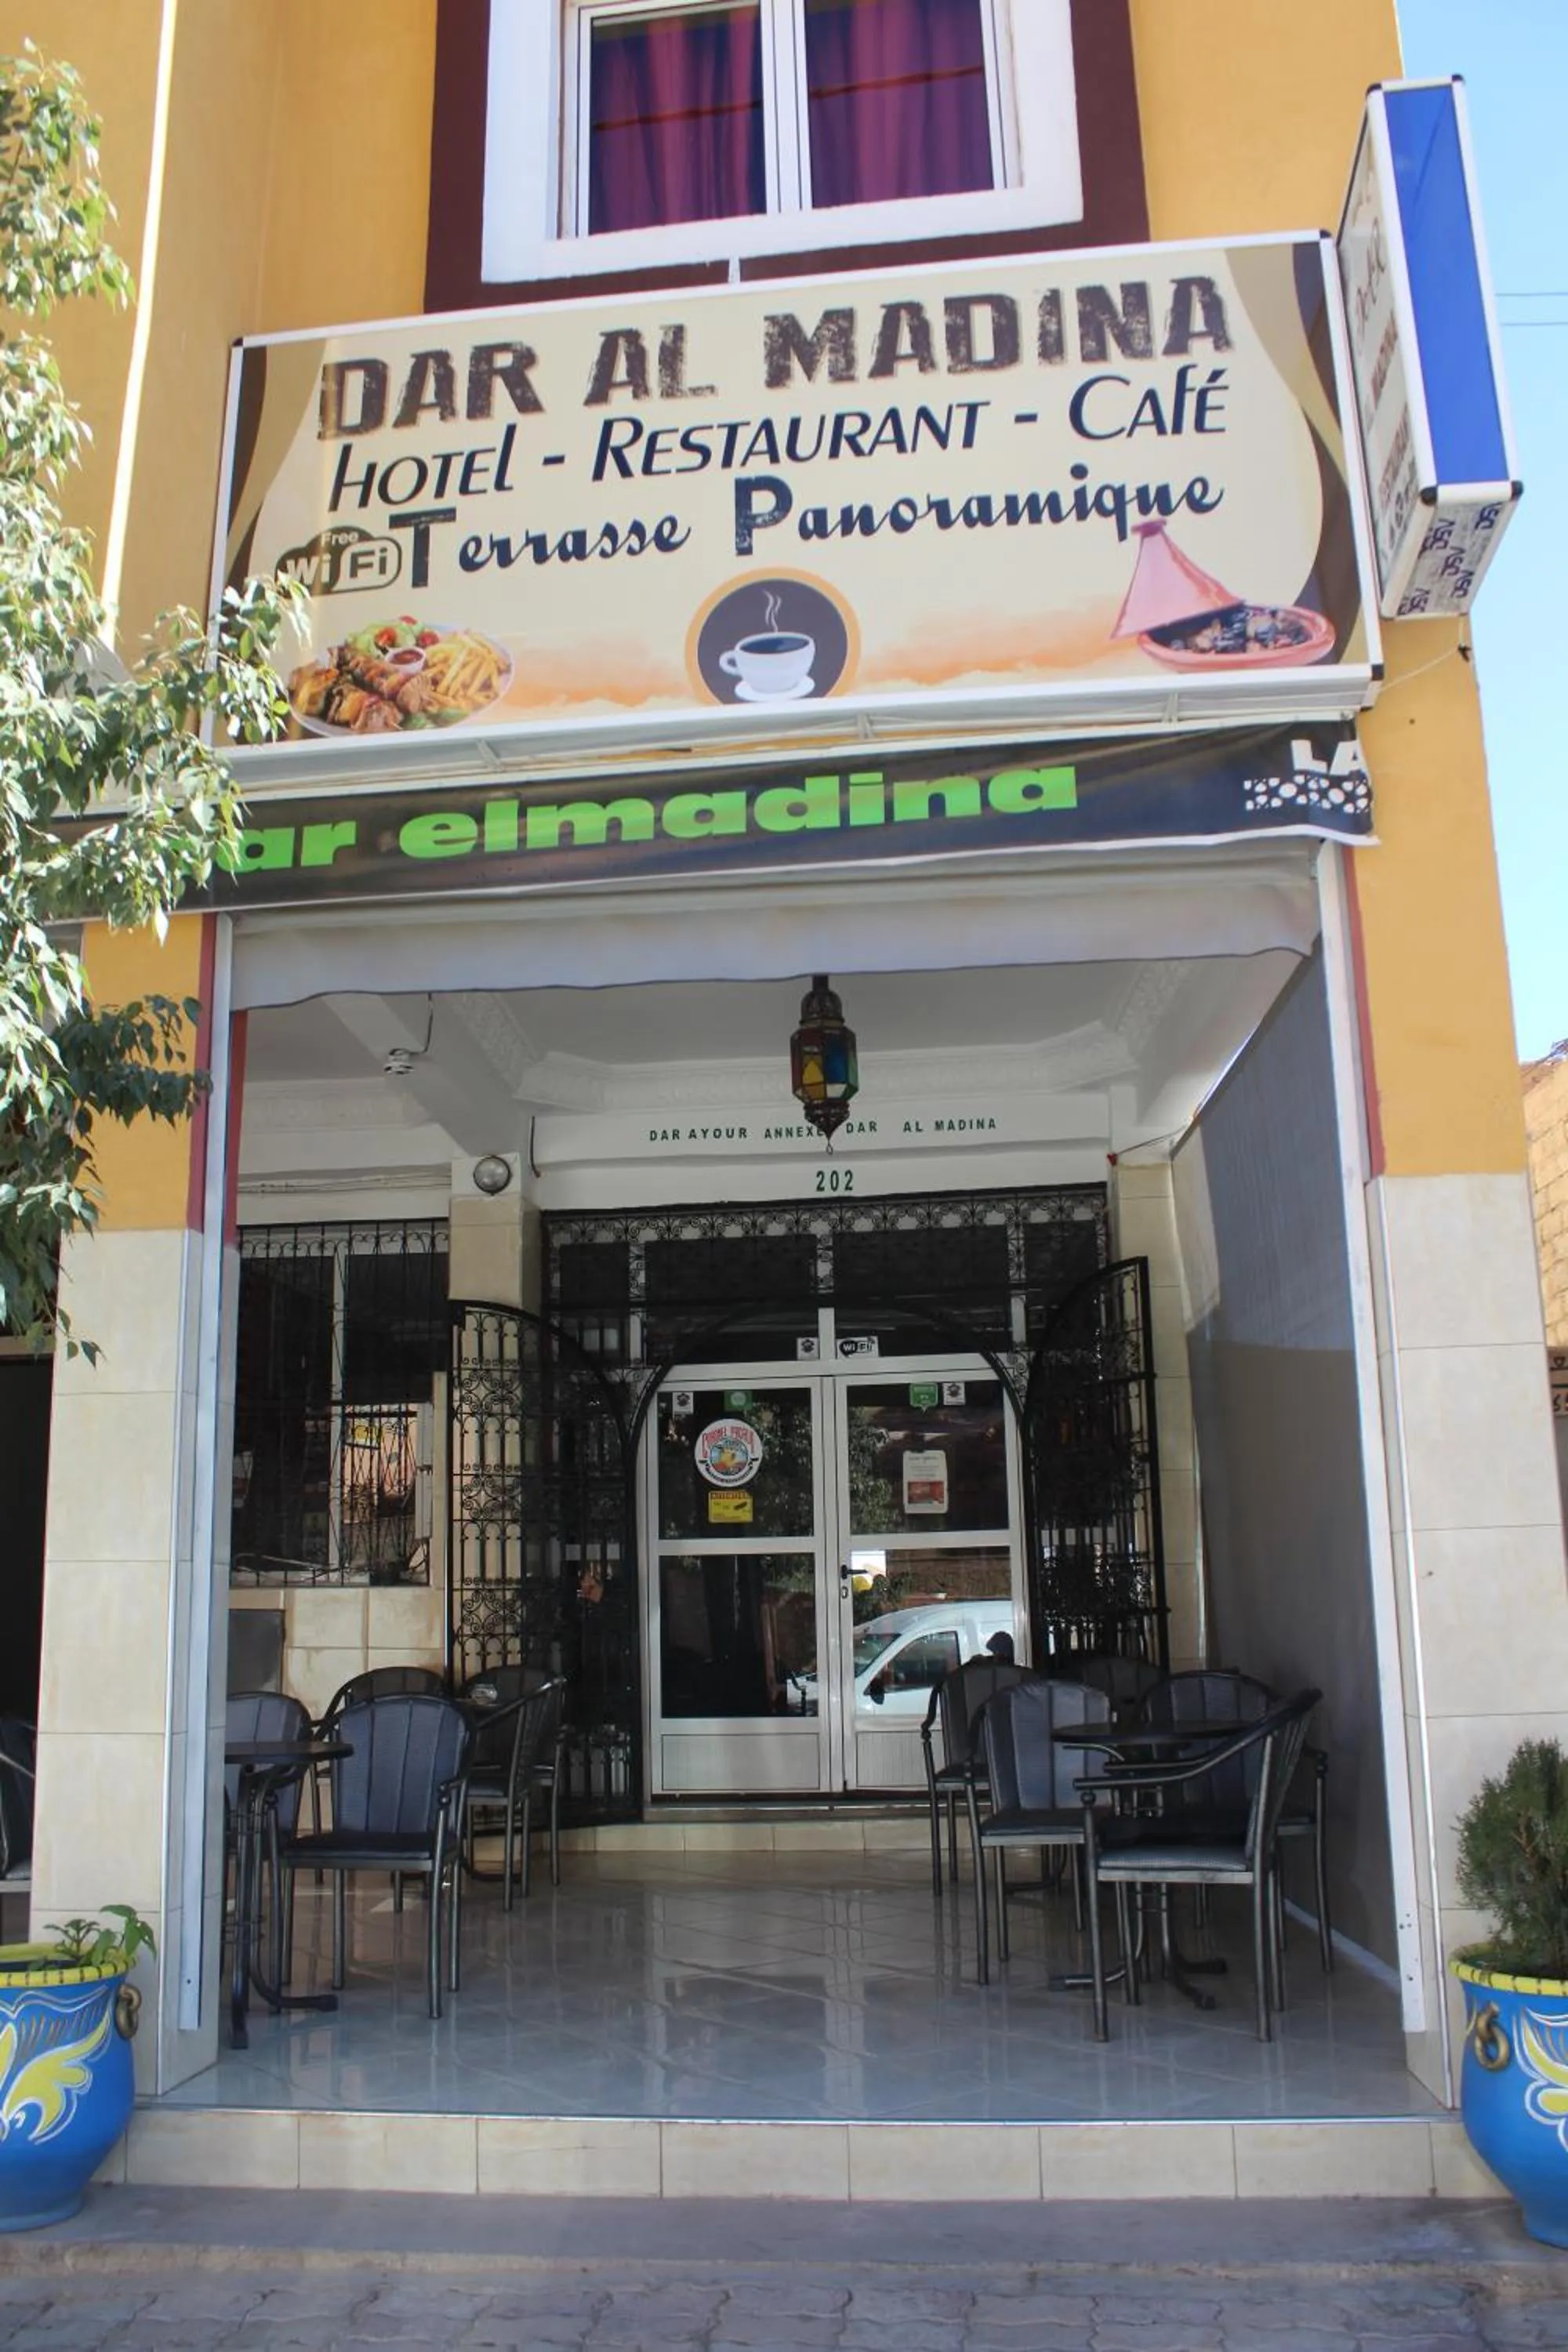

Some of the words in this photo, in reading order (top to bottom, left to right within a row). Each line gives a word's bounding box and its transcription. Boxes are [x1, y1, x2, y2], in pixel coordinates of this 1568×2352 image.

[317, 340, 545, 440] DAR
[583, 323, 718, 408] AL
[762, 274, 1233, 391] MADINA
[592, 401, 990, 481] RESTAURANT
[321, 531, 359, 546] Free
[389, 507, 692, 588] Terrasse
[734, 463, 1225, 557] Panoramique
[169, 819, 358, 876] ar
[398, 765, 1078, 860] elmadina
[649, 1129, 681, 1142] DAR
[688, 1127, 748, 1141] AYOUR
[846, 1120, 877, 1134] DAR
[903, 1120, 924, 1133] AL
[934, 1118, 996, 1131] MADINA
[816, 1170, 855, 1192] 202
